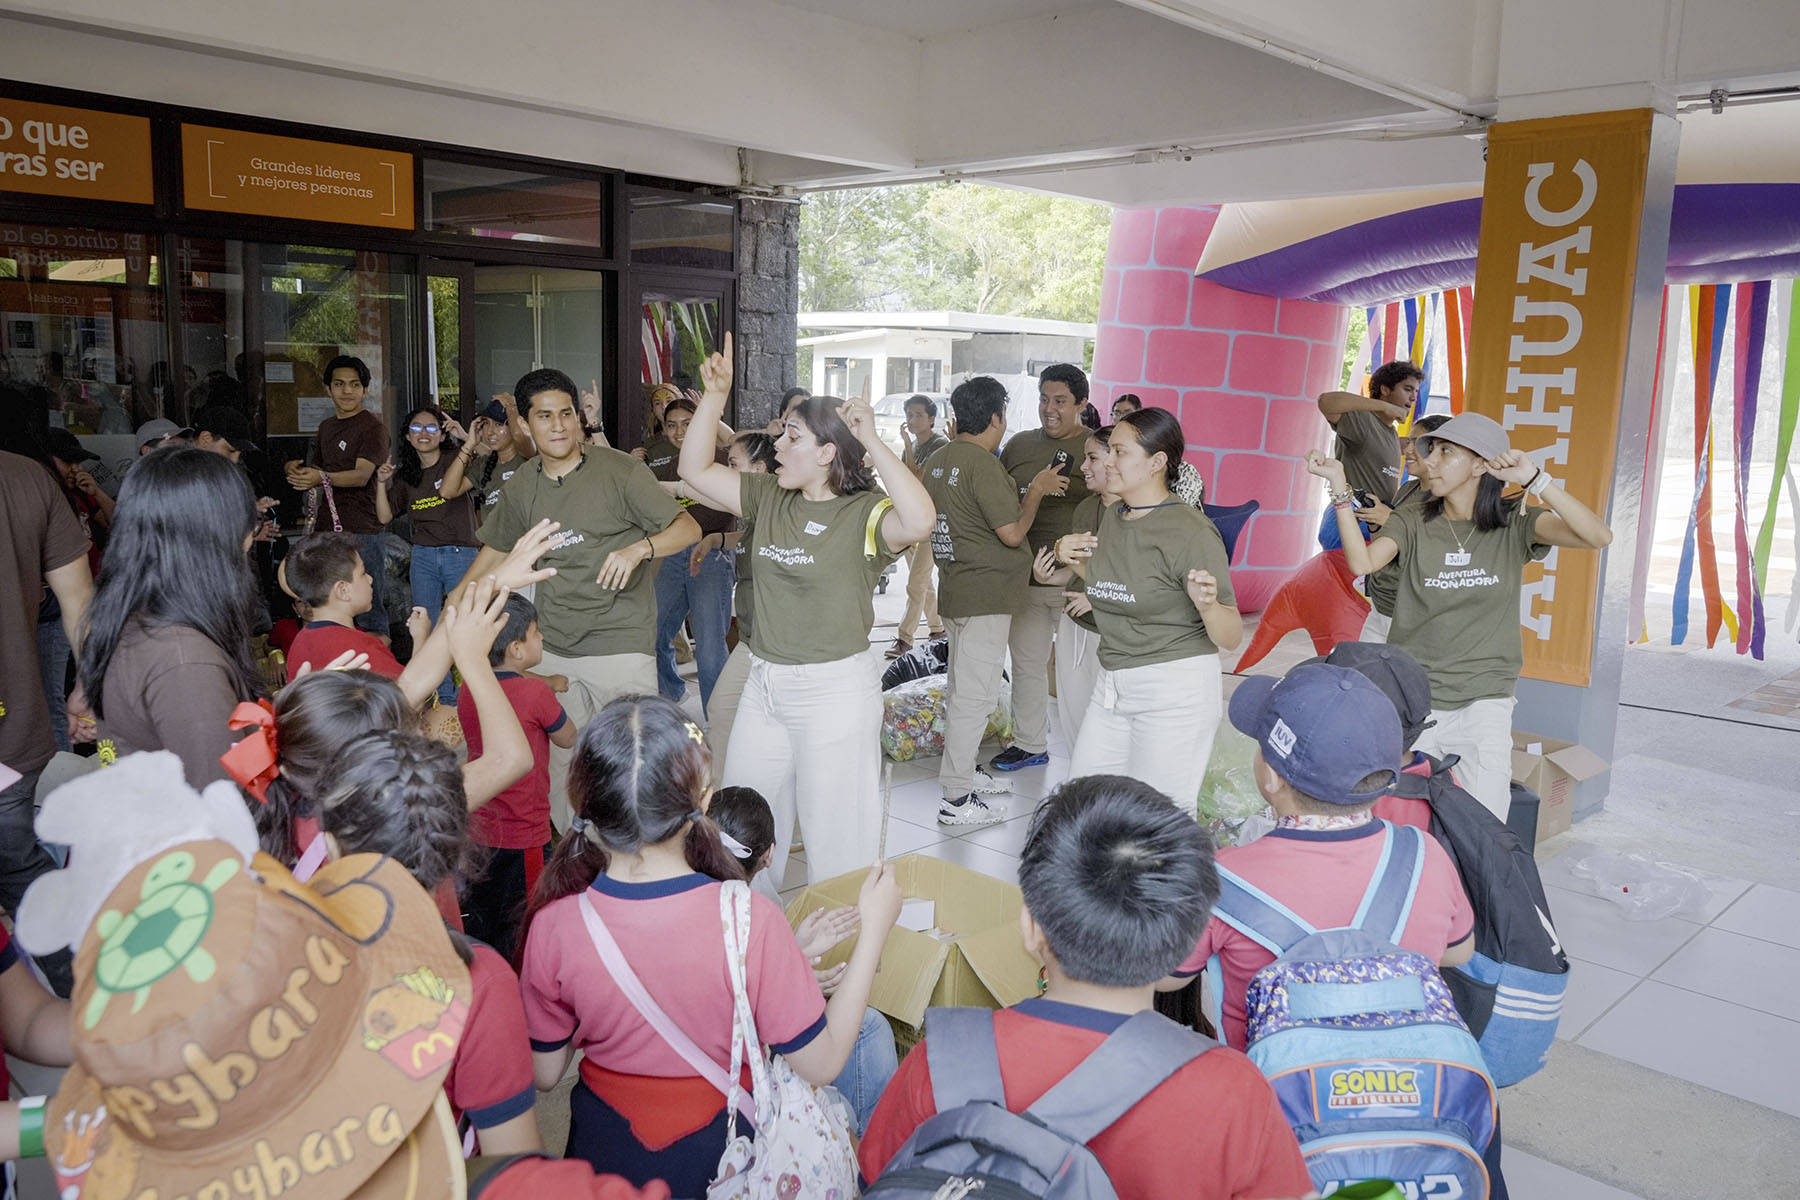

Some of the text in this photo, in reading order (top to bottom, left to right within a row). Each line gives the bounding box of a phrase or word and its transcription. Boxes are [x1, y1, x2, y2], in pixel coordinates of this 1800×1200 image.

[22, 119, 89, 155] que
[54, 157, 105, 181] ser
[250, 157, 361, 181] Grandes líderes
[237, 174, 374, 199] y mejores personas
[1095, 580, 1127, 592] AVENTURA
[1438, 568, 1486, 580] AVENTURA
[1275, 727, 1293, 747] IUV
[1331, 1069, 1417, 1096] SONIC
